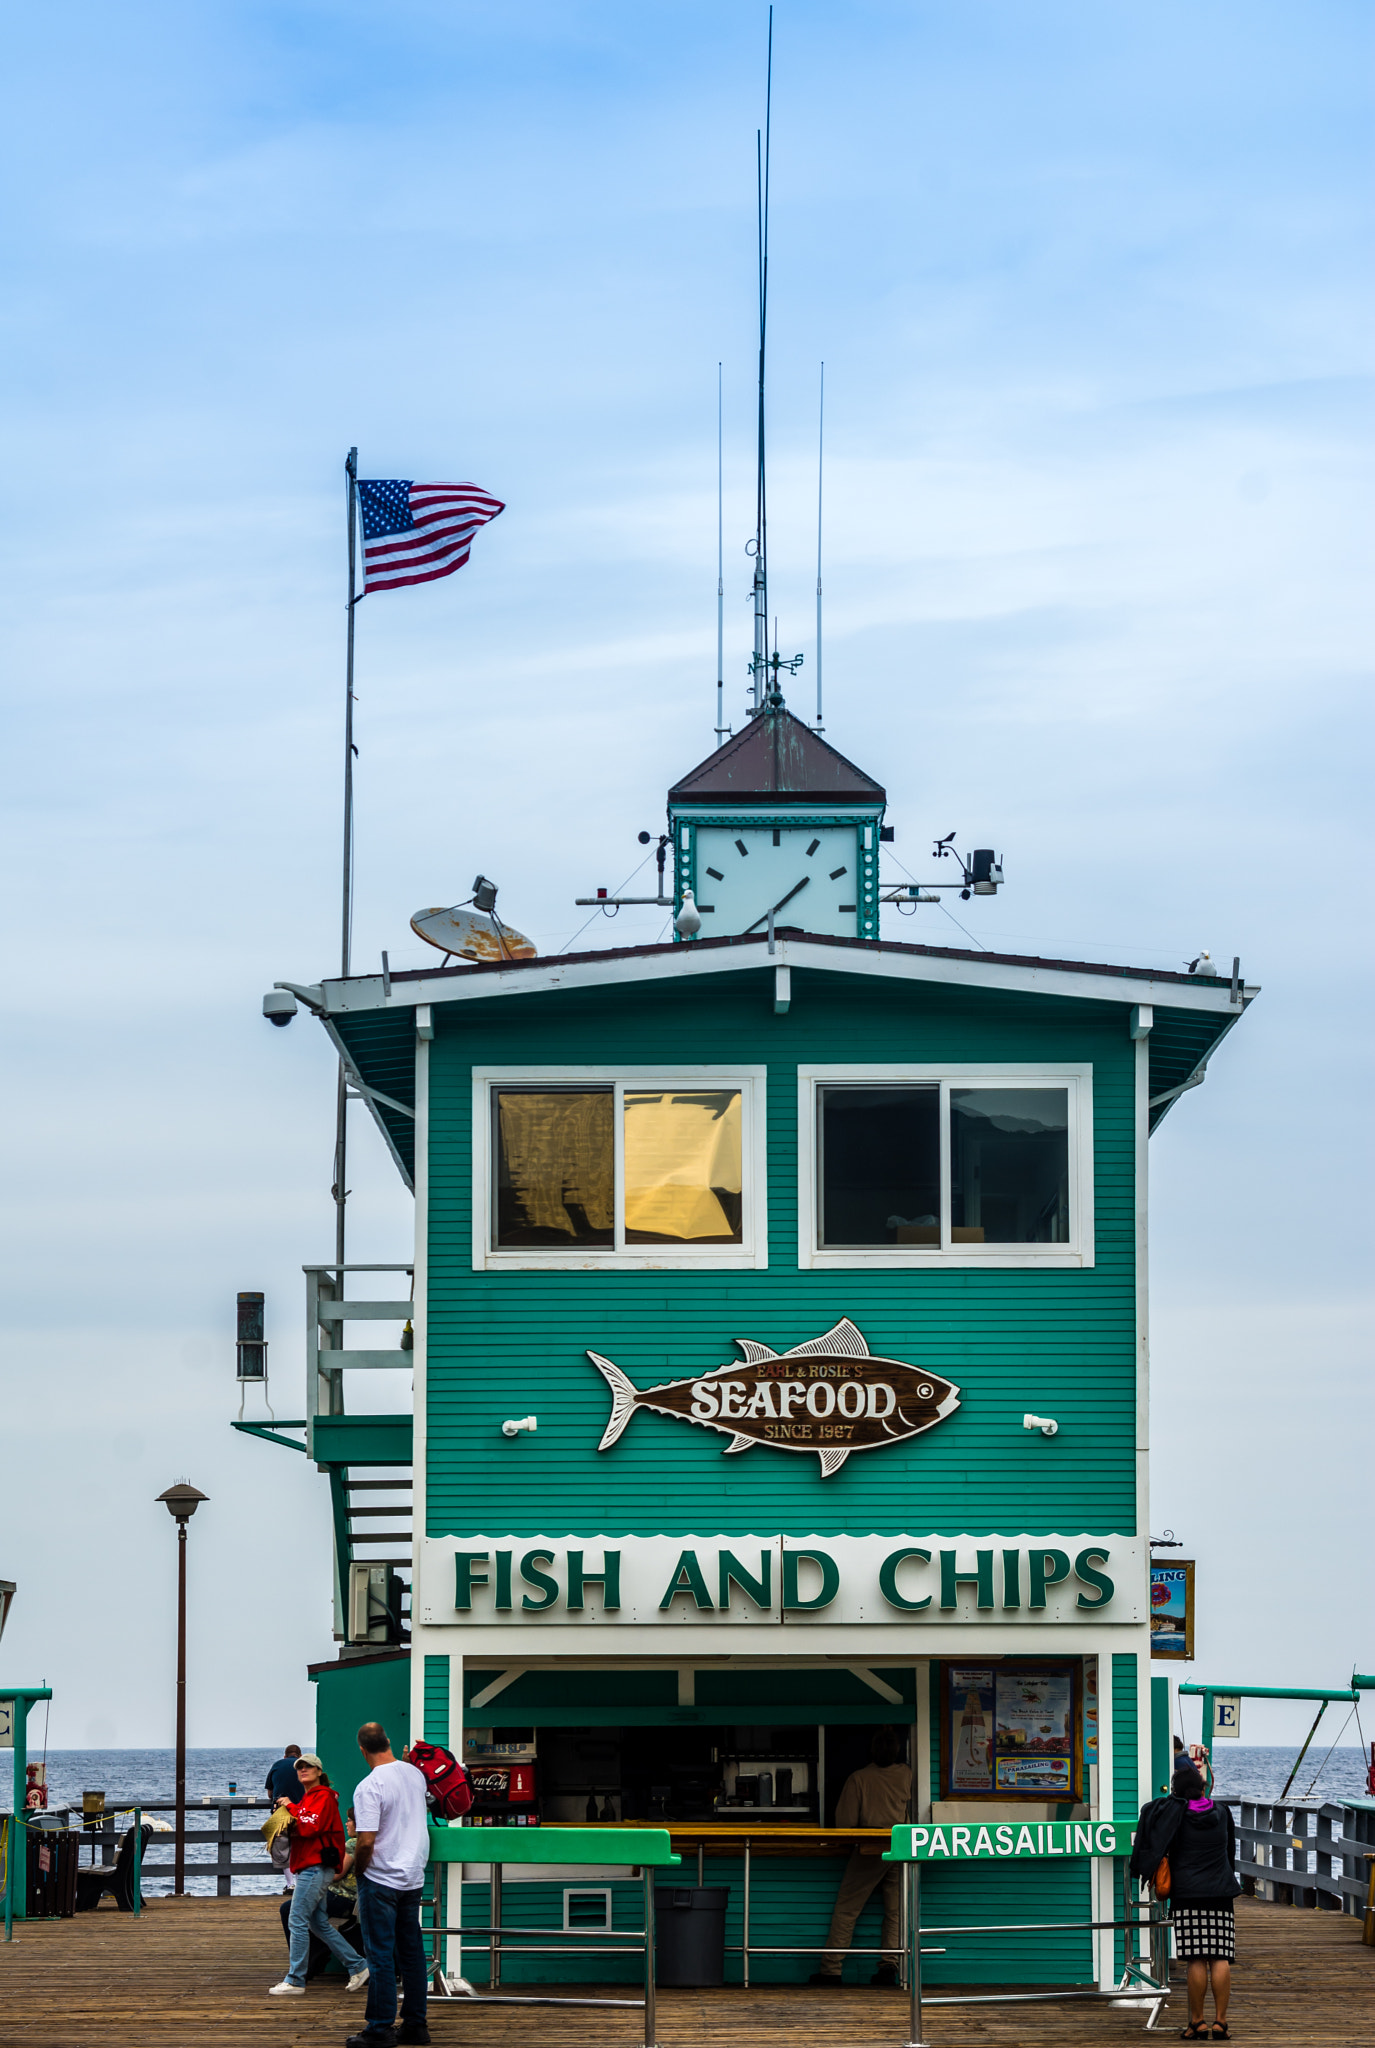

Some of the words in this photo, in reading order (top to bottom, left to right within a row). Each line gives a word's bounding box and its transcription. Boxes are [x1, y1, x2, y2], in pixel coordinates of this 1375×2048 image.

[757, 1366, 794, 1377] EARL
[797, 1366, 806, 1377] &
[809, 1365, 863, 1377] ROSIE'S
[690, 1381, 896, 1419] SEAFOOD
[765, 1424, 812, 1439] SINCE
[818, 1424, 855, 1439] 1967
[455, 1549, 621, 1611] FISH
[659, 1549, 840, 1611] AND
[879, 1547, 1115, 1611] CHIPS
[1217, 1705, 1235, 1727] E
[1007, 1761, 1050, 1773] PARASAILING
[910, 1823, 1116, 1857] PARASAILING
